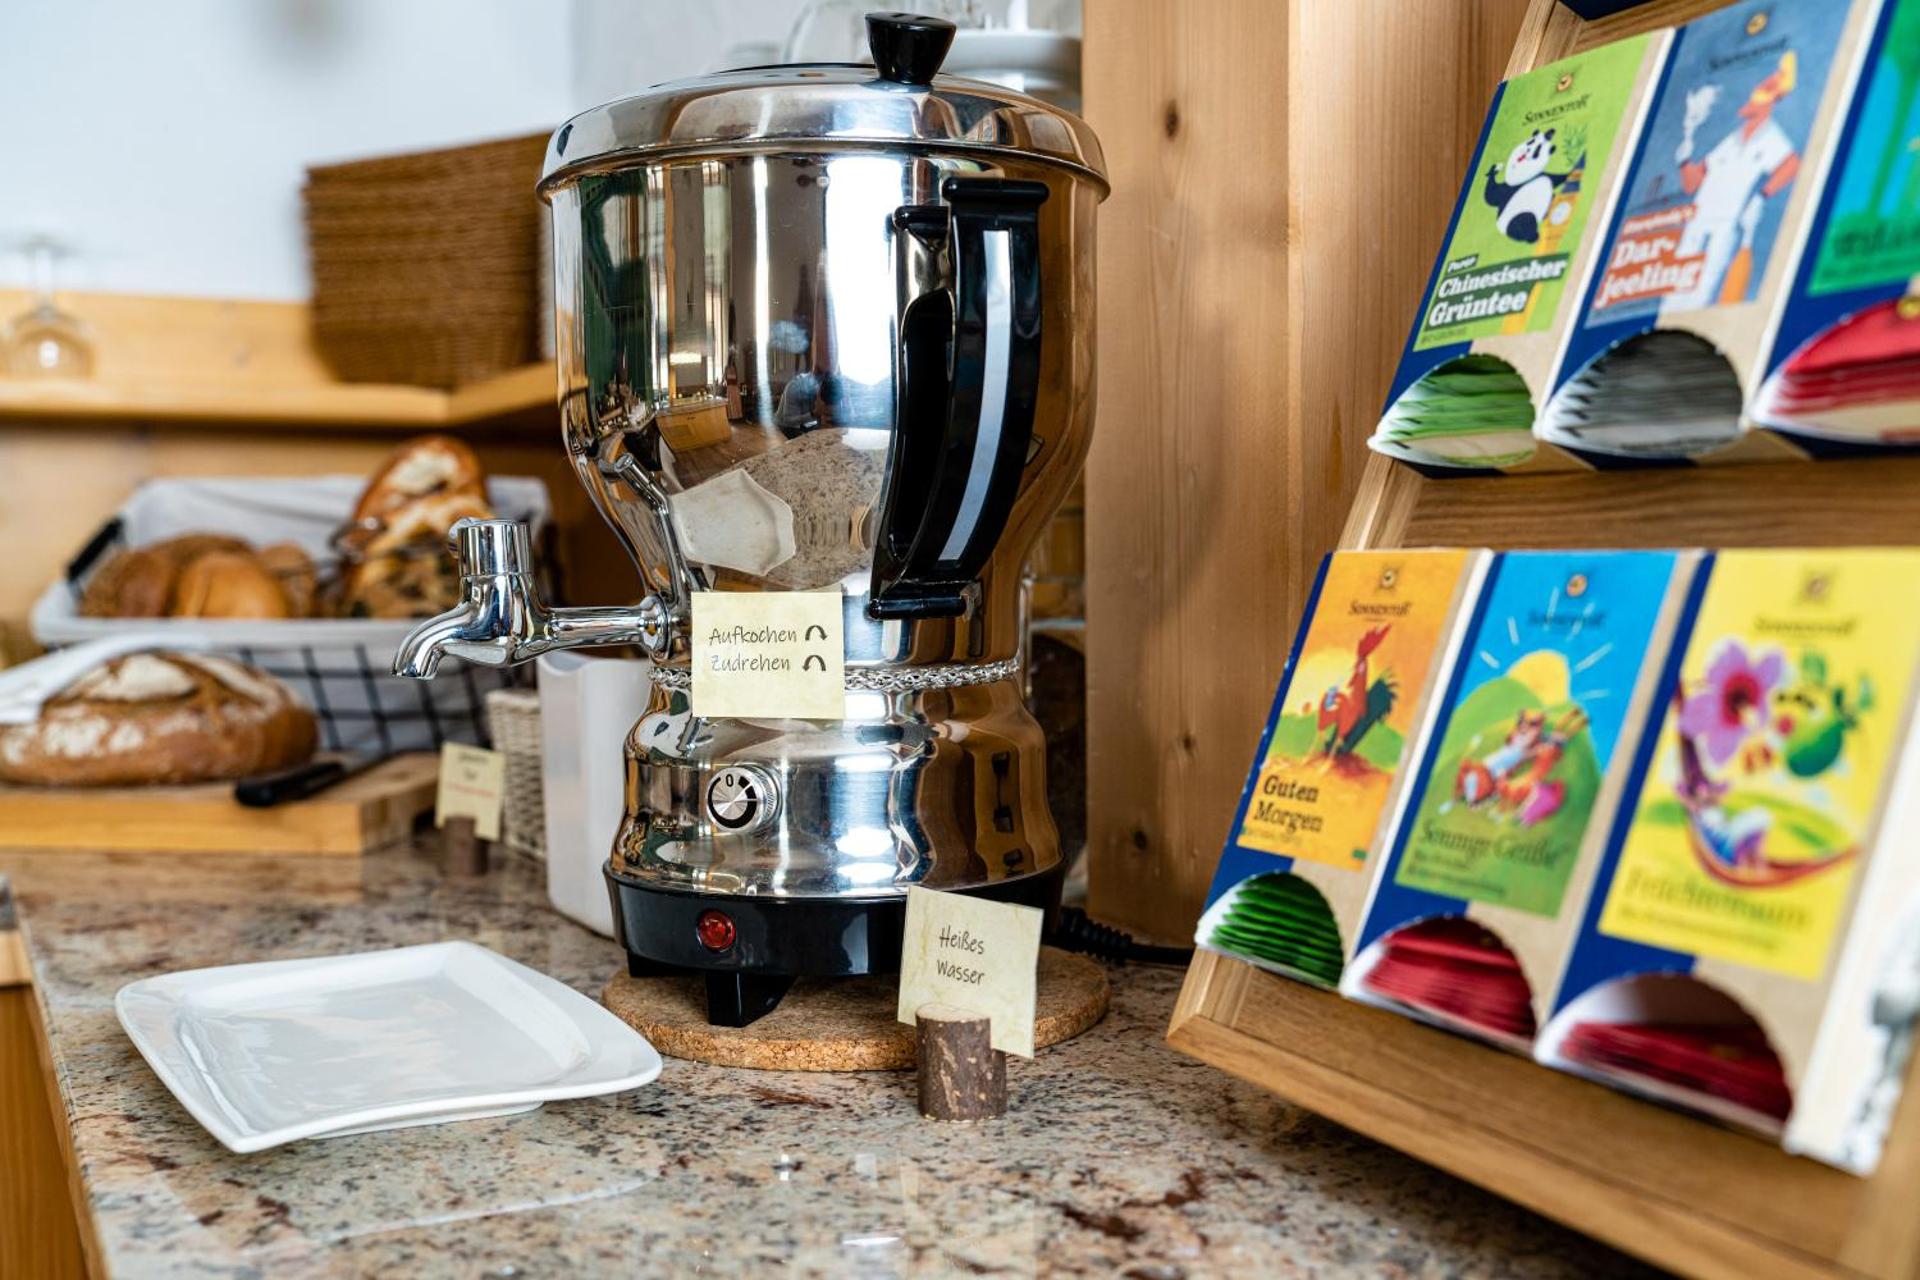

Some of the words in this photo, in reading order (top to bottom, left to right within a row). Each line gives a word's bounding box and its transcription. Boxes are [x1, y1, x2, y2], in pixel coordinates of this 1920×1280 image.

[1438, 260, 1568, 298] Chinesischer
[1429, 291, 1528, 327] Grüntee
[708, 625, 798, 646] Aufkochen
[711, 652, 791, 671] Zudrehen
[1263, 774, 1319, 803] Guten
[1253, 800, 1323, 834] Morgen
[939, 924, 985, 955] Heißes
[936, 959, 986, 986] Wasser
